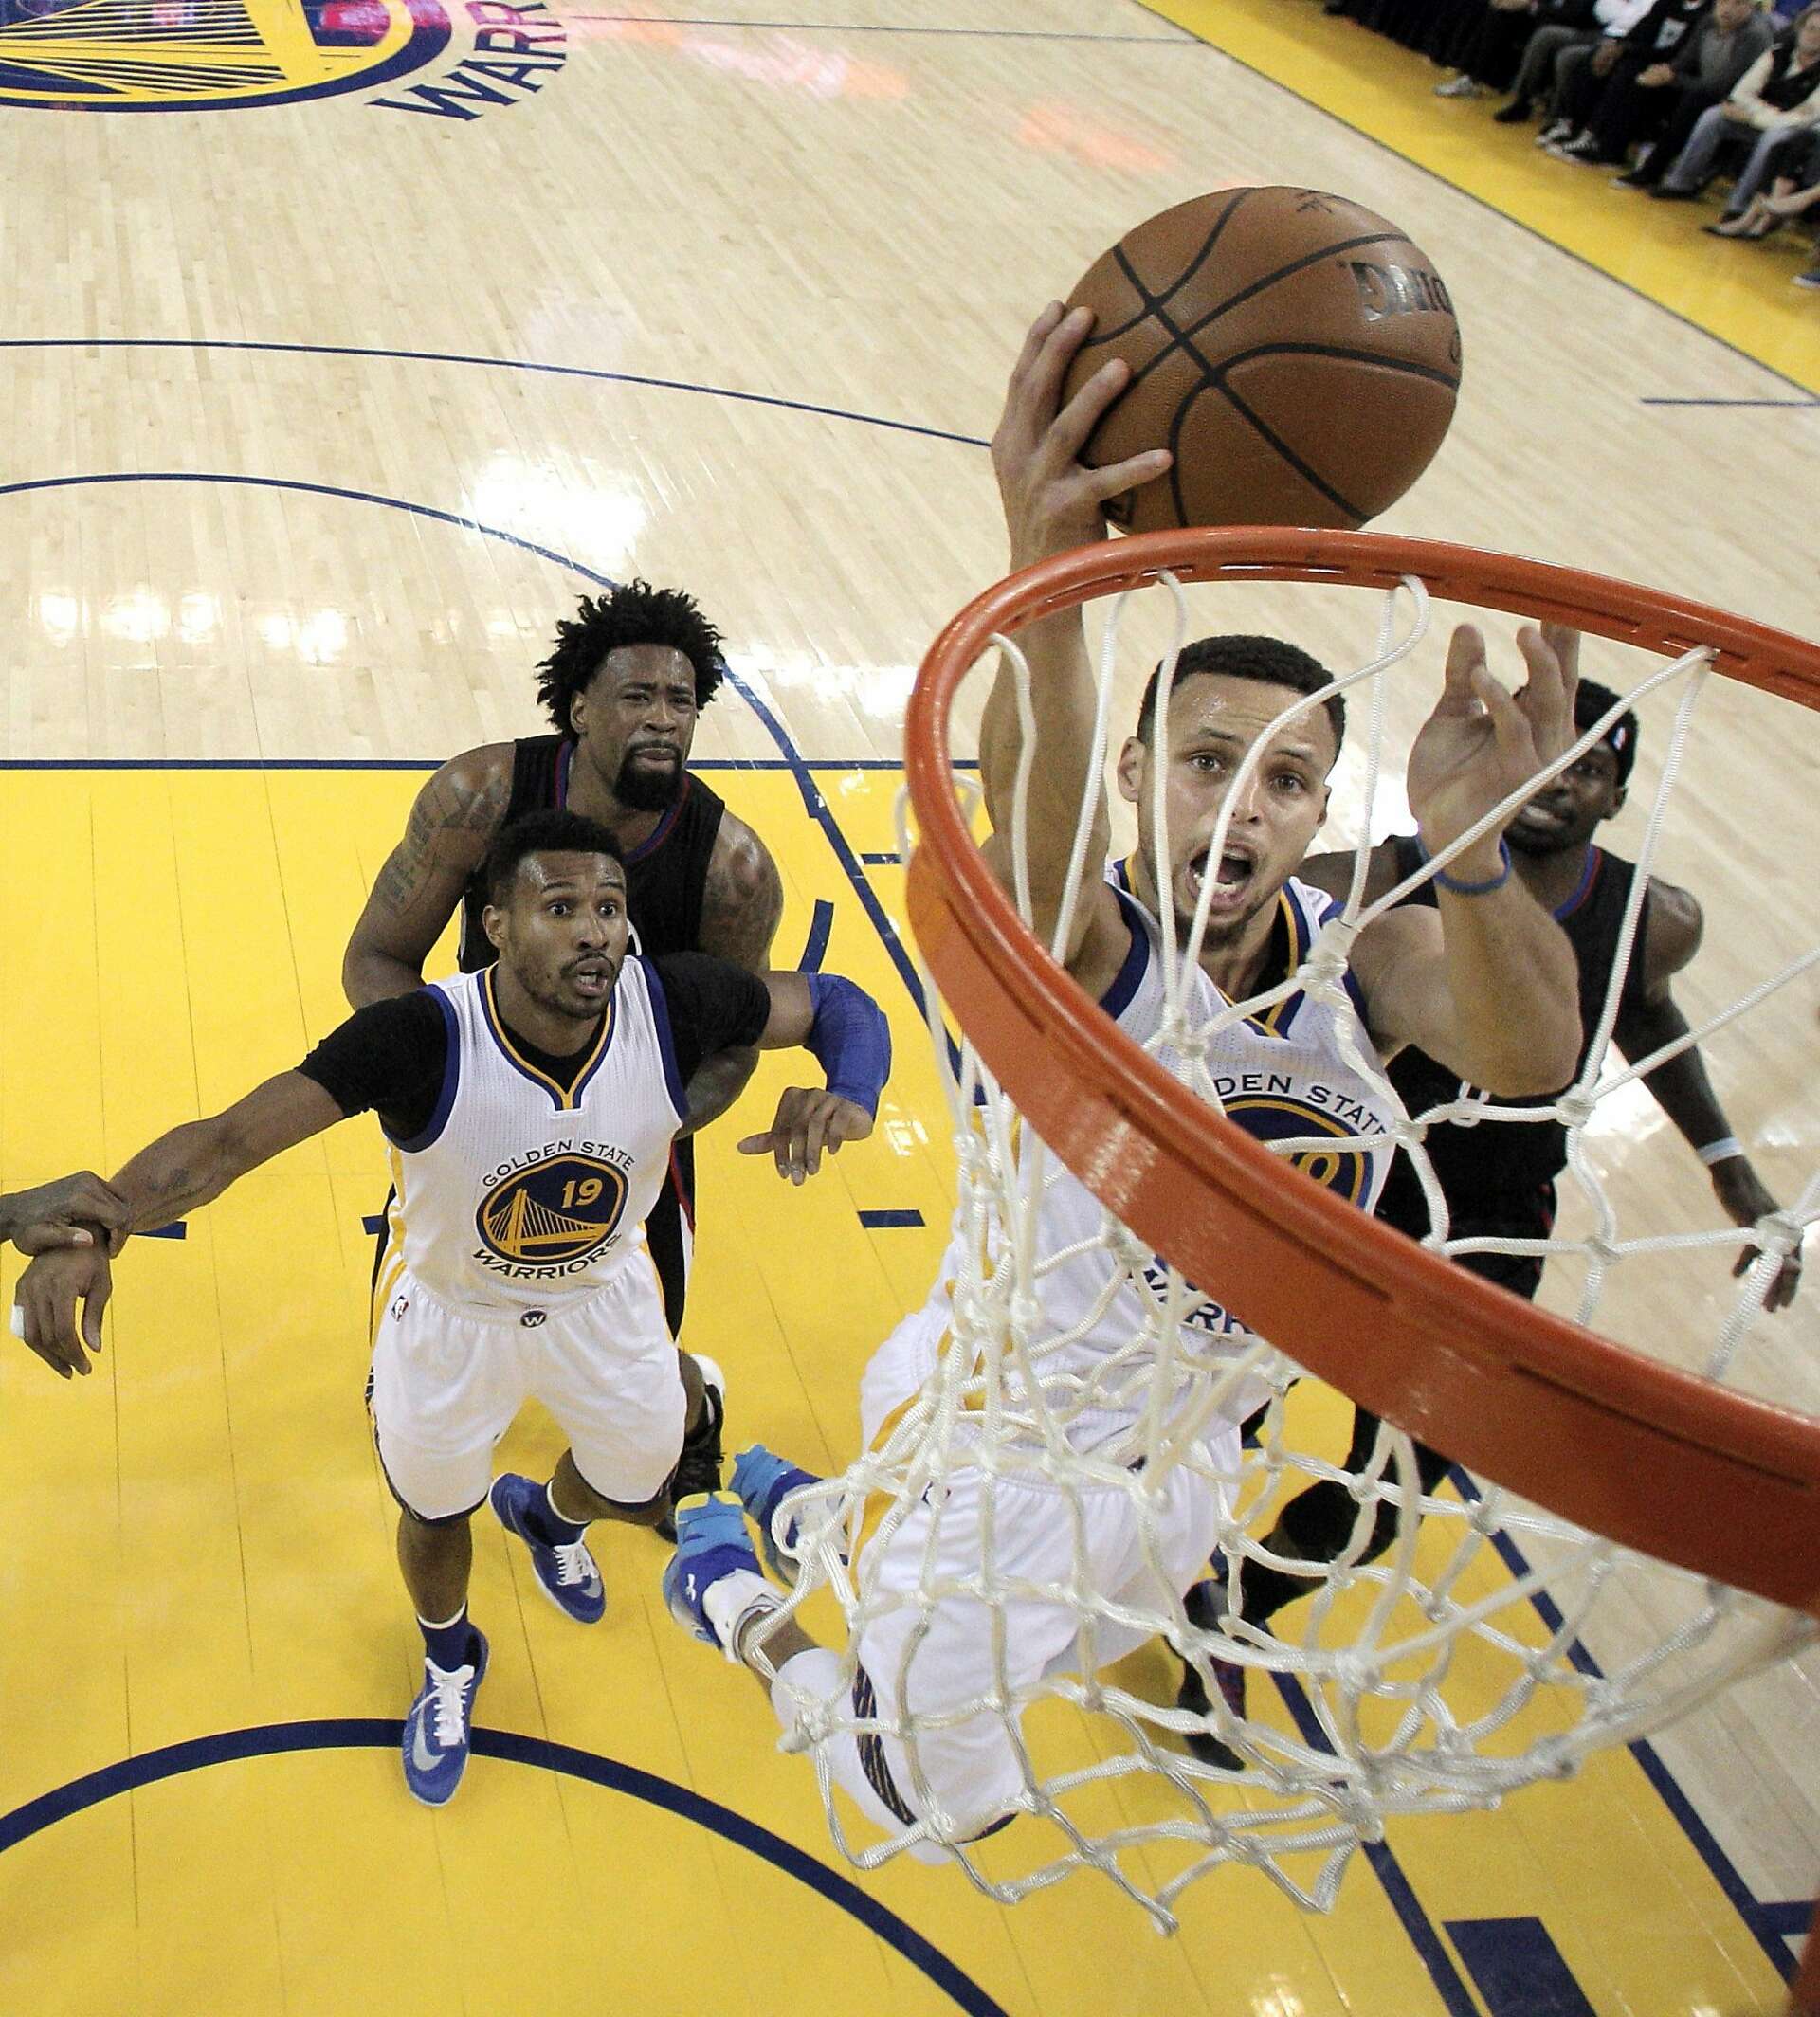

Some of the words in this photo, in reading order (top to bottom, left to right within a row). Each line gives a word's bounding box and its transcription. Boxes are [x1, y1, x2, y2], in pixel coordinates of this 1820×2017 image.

[482, 1139, 573, 1187] GOLDEN
[581, 1141, 635, 1172] STATE
[562, 1178, 604, 1208] 19
[524, 1314, 545, 1327] W
